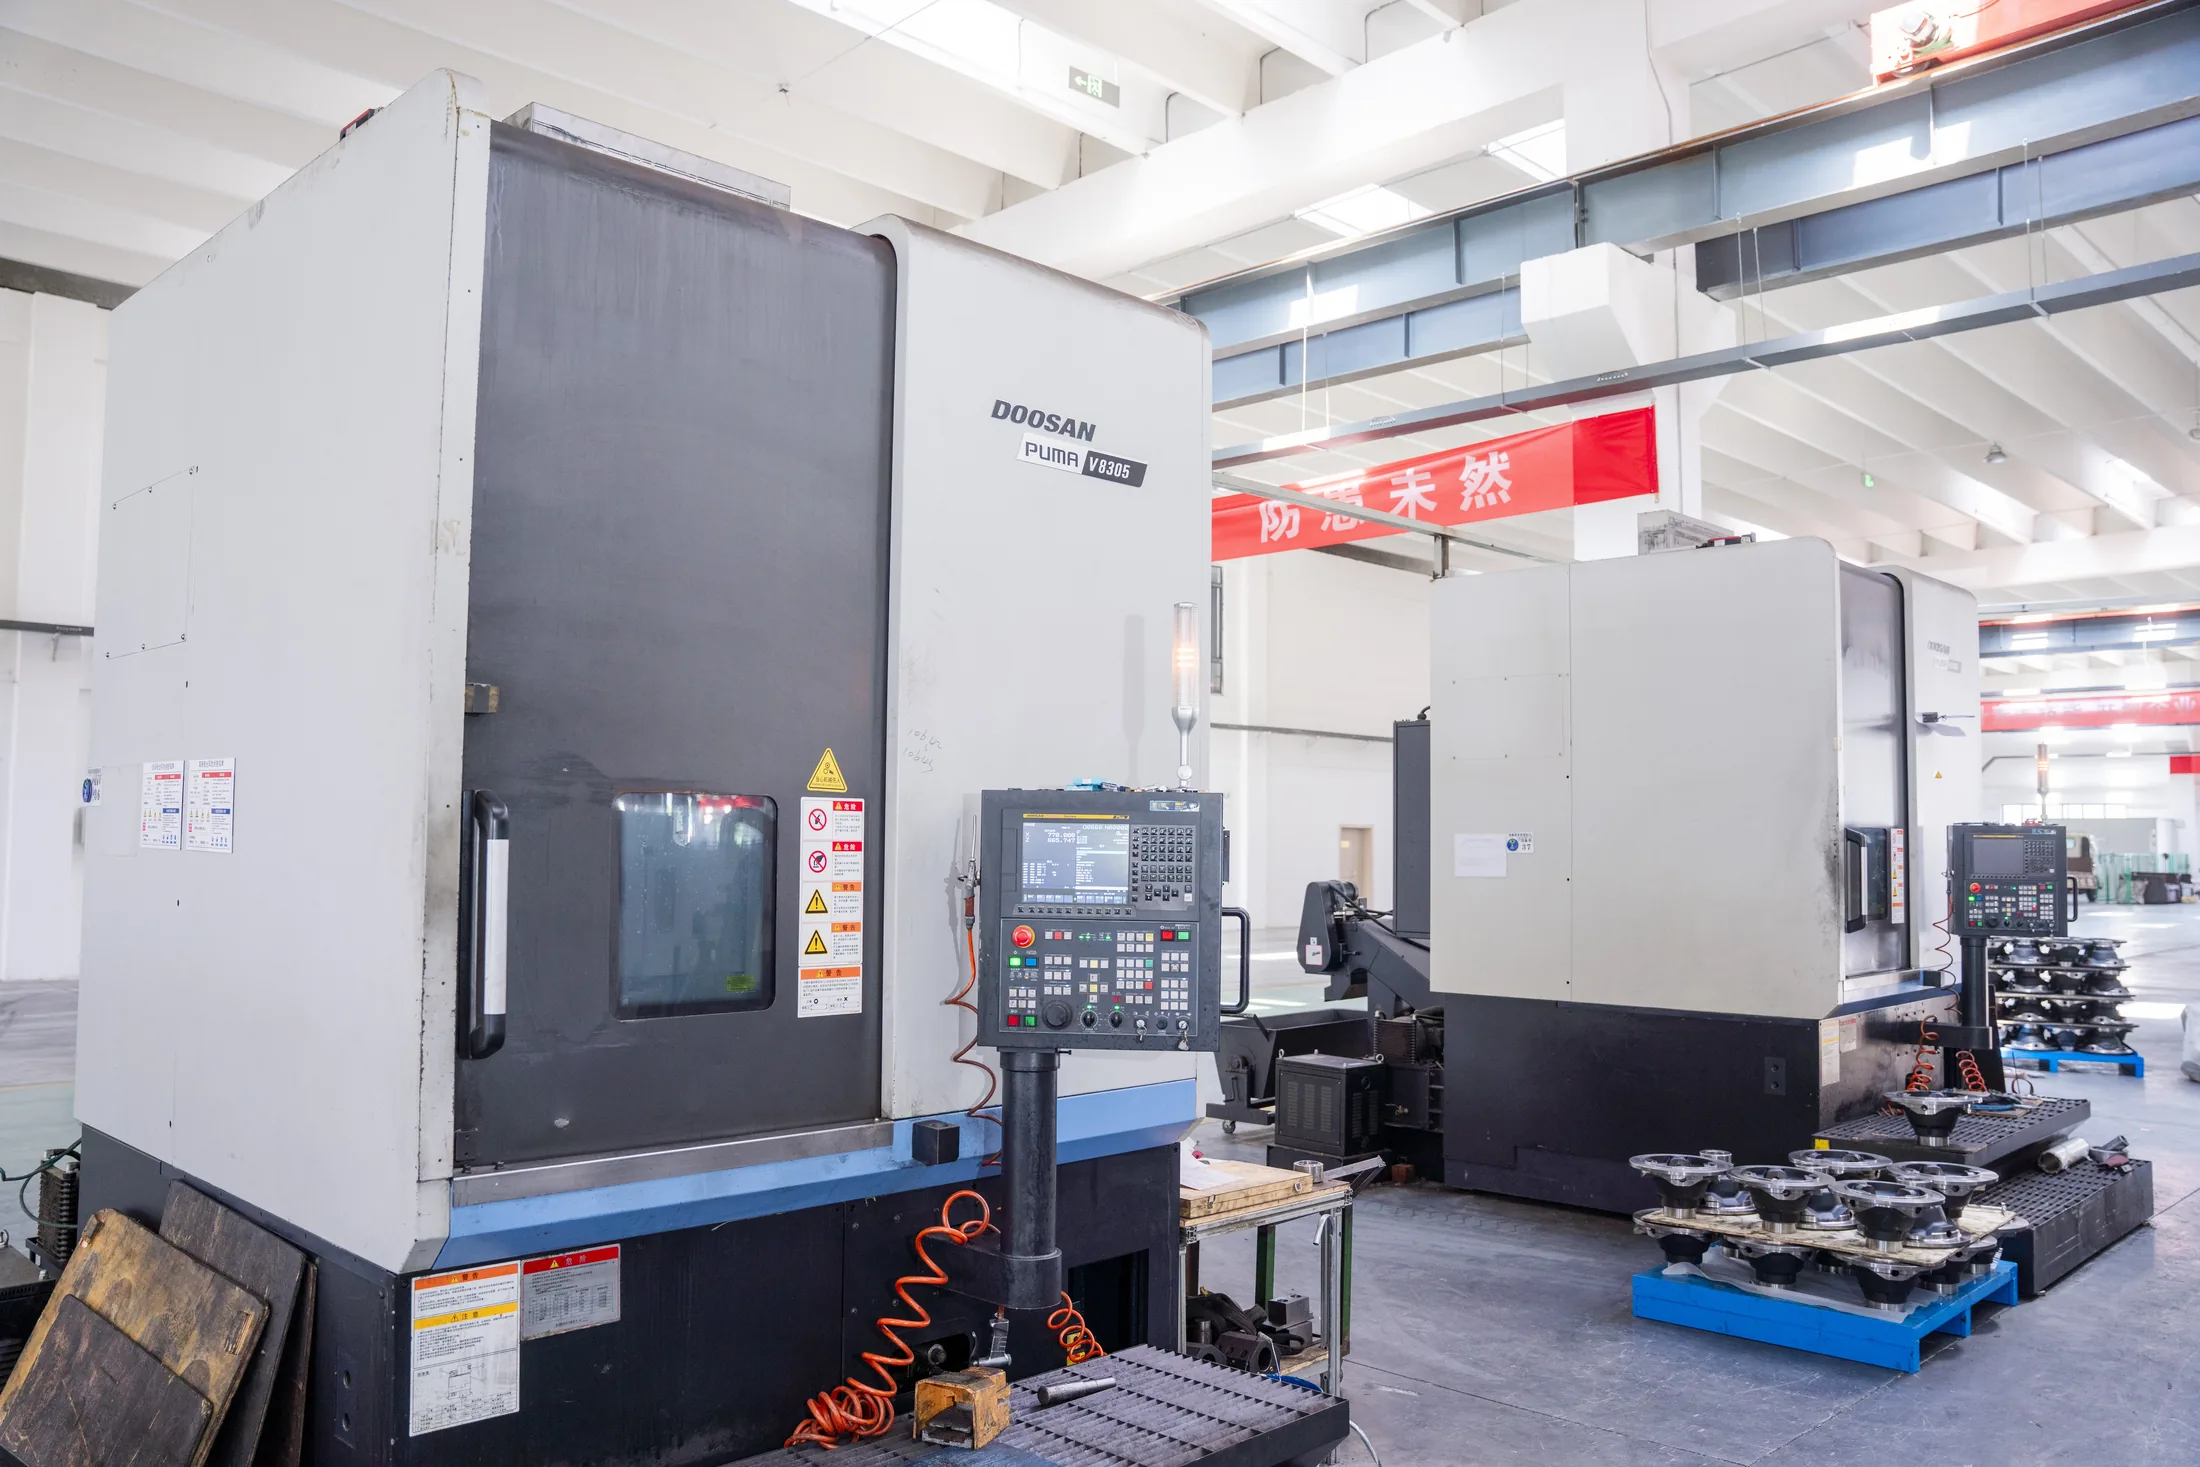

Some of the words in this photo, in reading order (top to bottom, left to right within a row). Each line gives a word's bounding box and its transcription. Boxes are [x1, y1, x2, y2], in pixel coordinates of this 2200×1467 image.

[991, 399, 1096, 442] DOOSAN
[1025, 441, 1079, 468] PUMA
[1089, 456, 1131, 479] V8305
[843, 803, 856, 811] 危险
[843, 843, 856, 851] 危险
[842, 883, 856, 891] 警告
[825, 969, 842, 977] 警告
[565, 1254, 587, 1266] 危险
[462, 1272, 479, 1281] 警告
[461, 1311, 479, 1320] 注意
